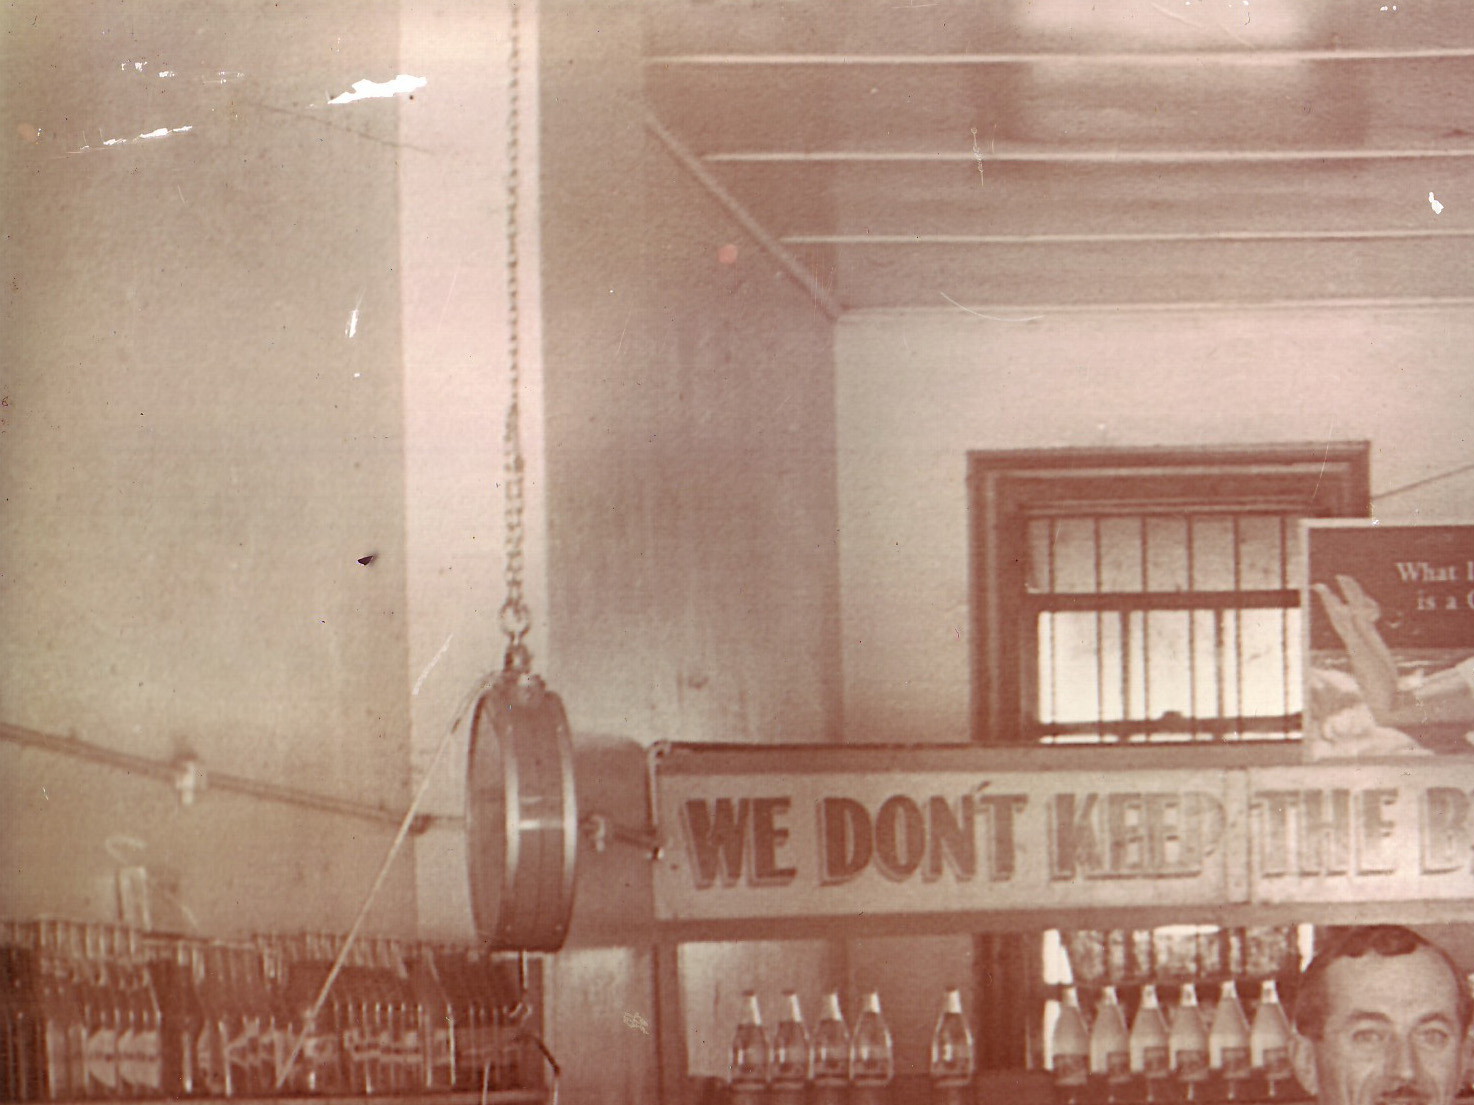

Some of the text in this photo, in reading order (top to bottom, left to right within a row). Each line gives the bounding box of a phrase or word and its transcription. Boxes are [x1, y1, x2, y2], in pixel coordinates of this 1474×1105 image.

[1395, 561, 1457, 583] What
[1467, 561, 1474, 581] I
[1416, 590, 1437, 611] is
[1445, 597, 1457, 610] a
[679, 796, 797, 889] WE
[816, 781, 1029, 887] DON'T
[1049, 792, 1226, 882] KEEP
[1249, 788, 1398, 878] THE
